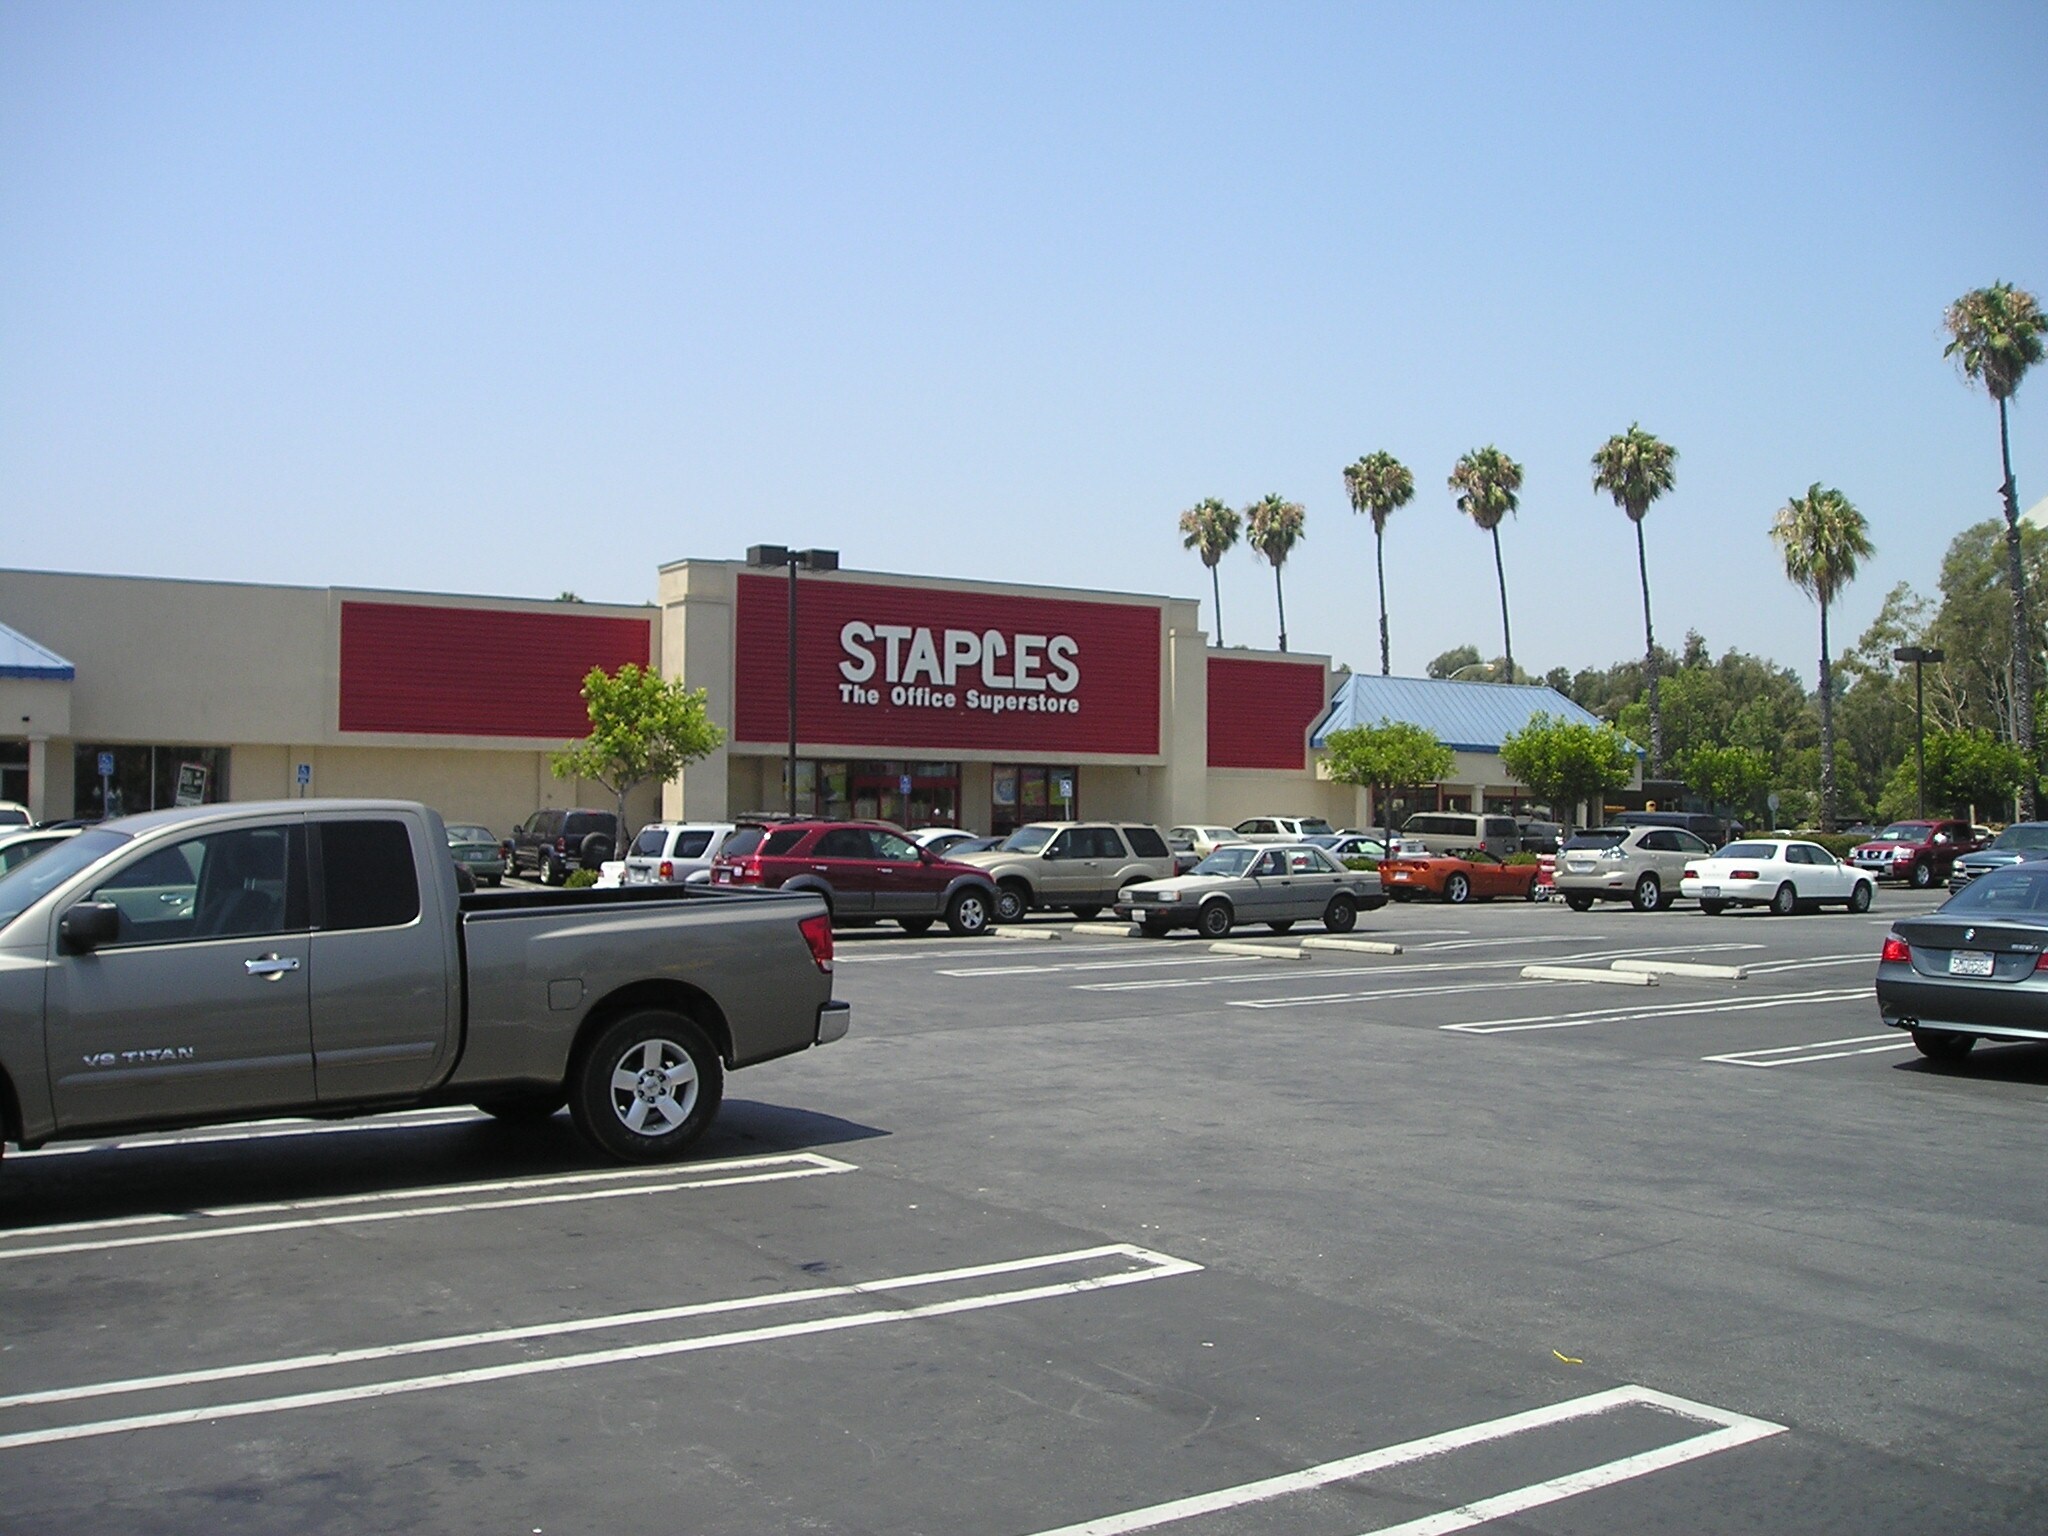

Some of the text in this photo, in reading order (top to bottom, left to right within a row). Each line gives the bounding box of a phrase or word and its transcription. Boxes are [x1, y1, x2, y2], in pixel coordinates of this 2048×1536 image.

[838, 620, 1080, 693] STAPLES
[838, 683, 1080, 714] The Office Superstore
[82, 1046, 194, 1067] V8 TITAN
